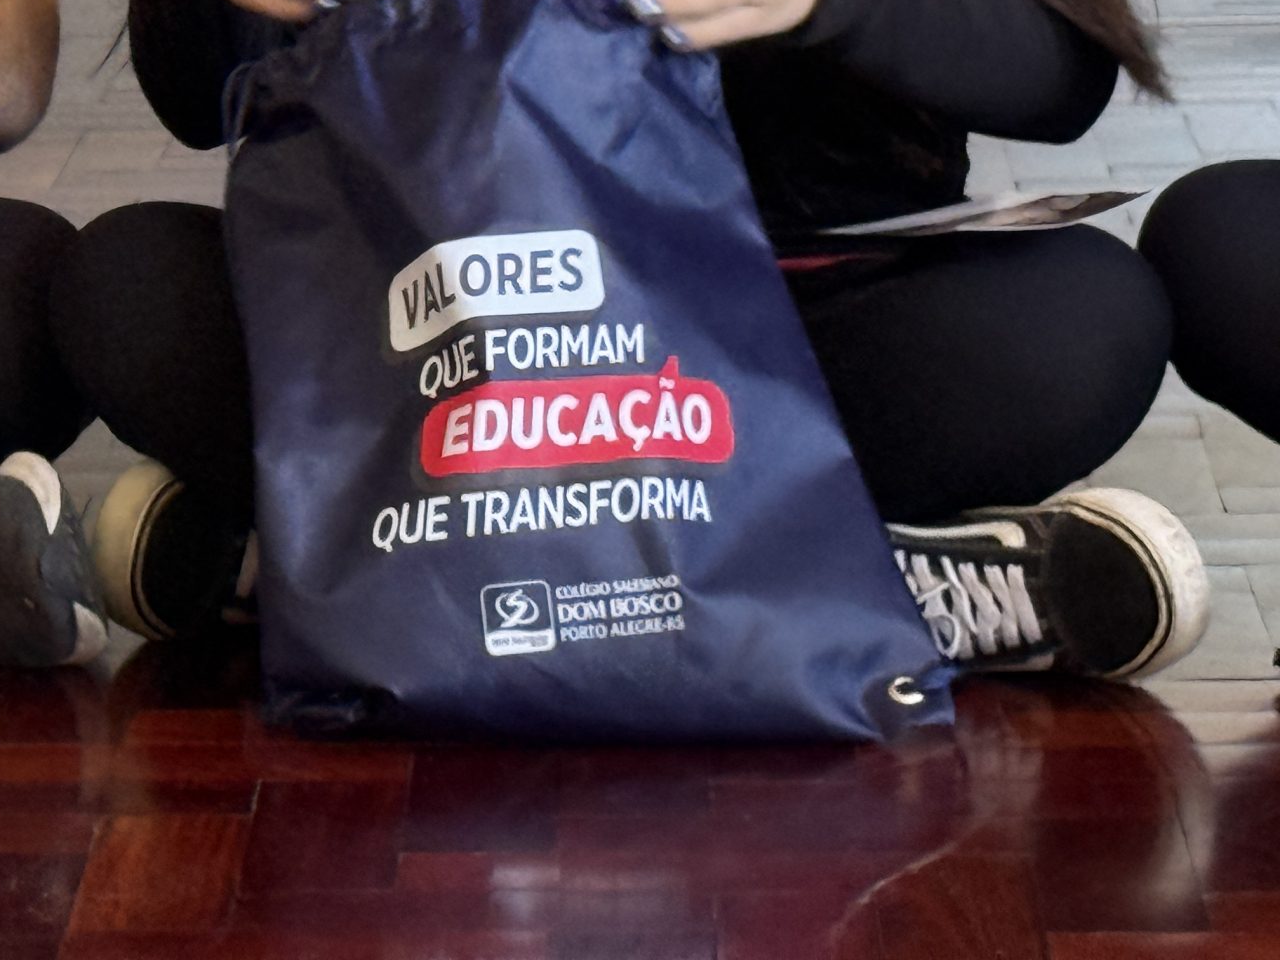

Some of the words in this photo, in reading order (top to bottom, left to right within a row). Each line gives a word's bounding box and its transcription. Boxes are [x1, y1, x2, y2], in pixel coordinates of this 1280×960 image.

[401, 247, 584, 330] VALORES
[420, 334, 479, 398] QUE
[484, 323, 645, 371] FORMAM
[441, 378, 712, 458] EDUCAÇÃO
[372, 496, 450, 552] QUE
[460, 476, 712, 537] TRANSFORMA
[557, 599, 607, 623] DOM
[610, 591, 684, 619] BOSCO
